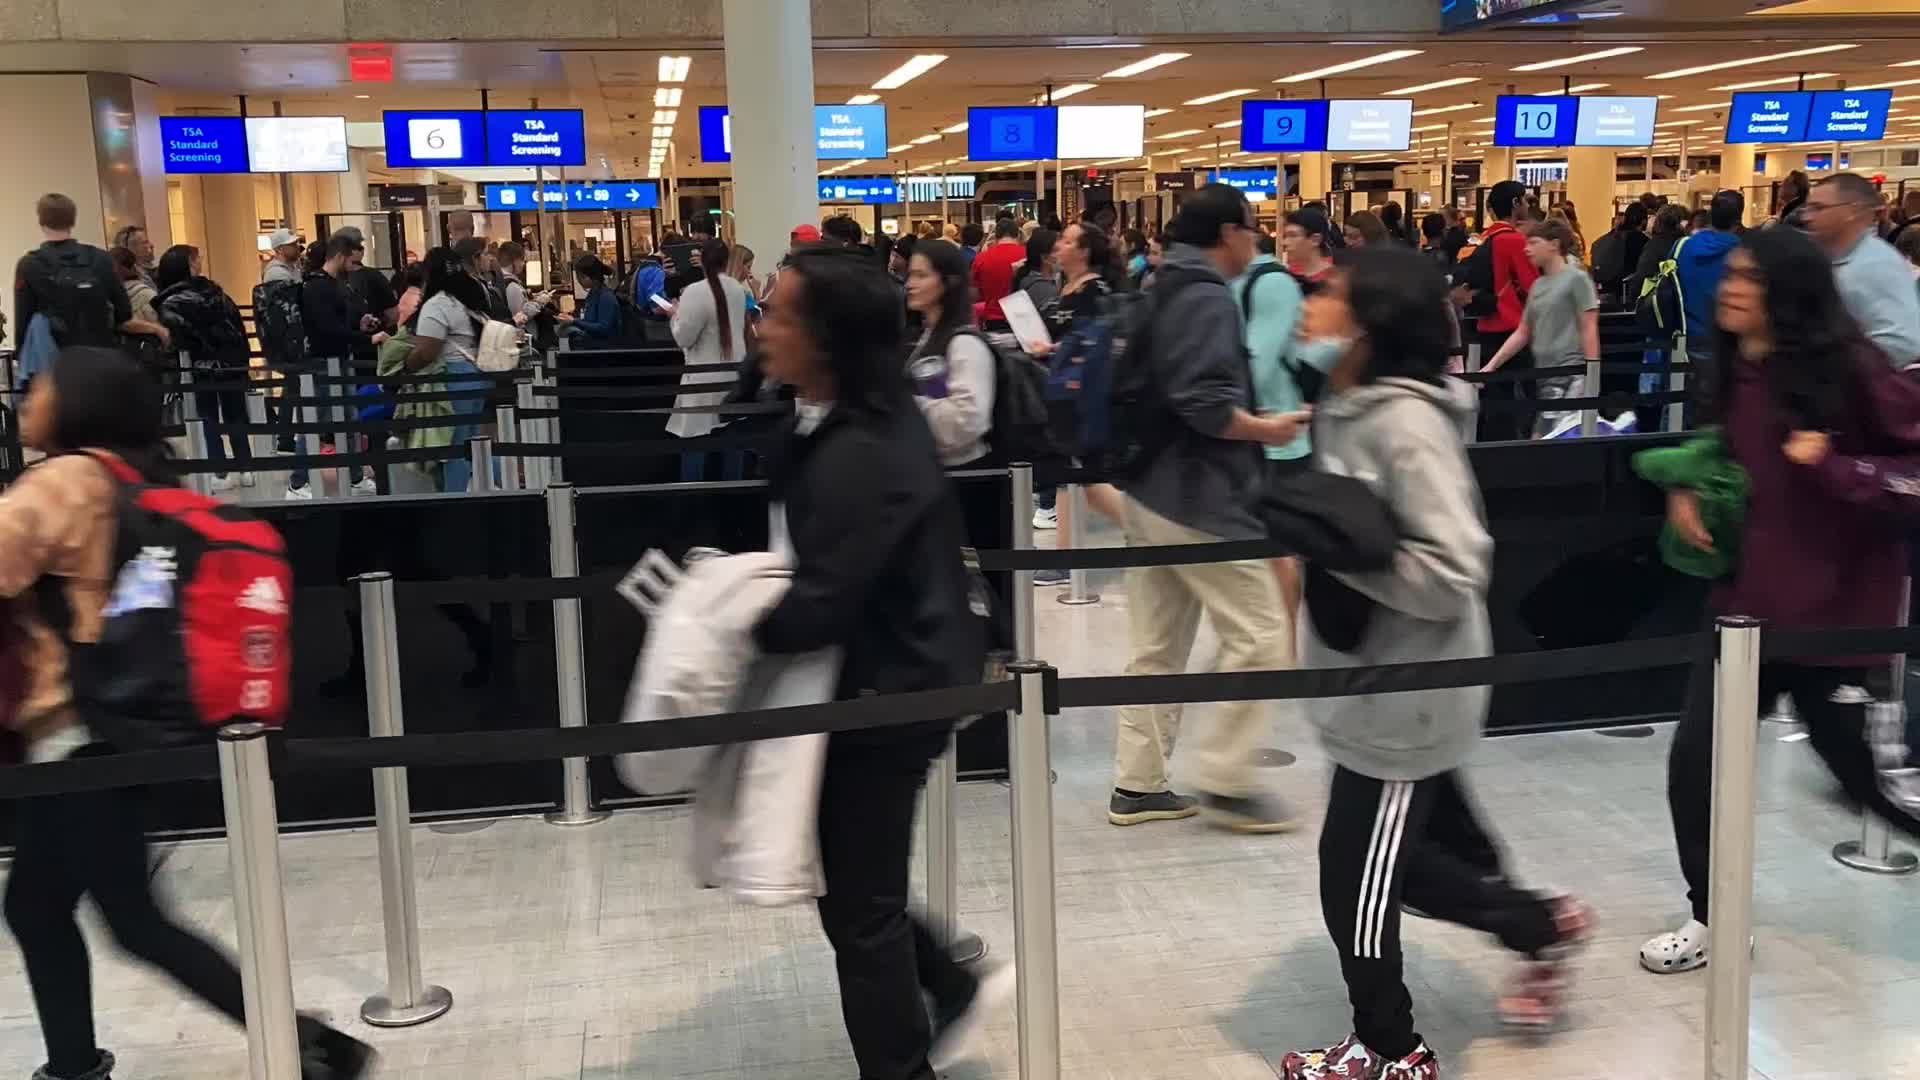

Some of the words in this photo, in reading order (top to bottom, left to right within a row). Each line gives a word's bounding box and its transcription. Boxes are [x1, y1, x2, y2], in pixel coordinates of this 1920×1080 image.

[1764, 100, 1780, 110] TSA
[1844, 99, 1860, 109] TSA
[1751, 112, 1790, 122] Standard
[1831, 110, 1870, 120] Standard
[524, 120, 545, 130] TSA
[1277, 116, 1293, 136] 9
[1520, 111, 1551, 131] 10
[182, 127, 204, 137] TSA
[1747, 124, 1789, 134] Screening
[1827, 122, 1867, 132] Screening
[427, 128, 445, 150] 6
[512, 132, 560, 143] Standard
[1004, 124, 1021, 144] 8
[170, 140, 219, 150] Standard
[511, 144, 562, 157] Screening
[169, 152, 222, 164] Screening
[575, 190, 582, 201] 1
